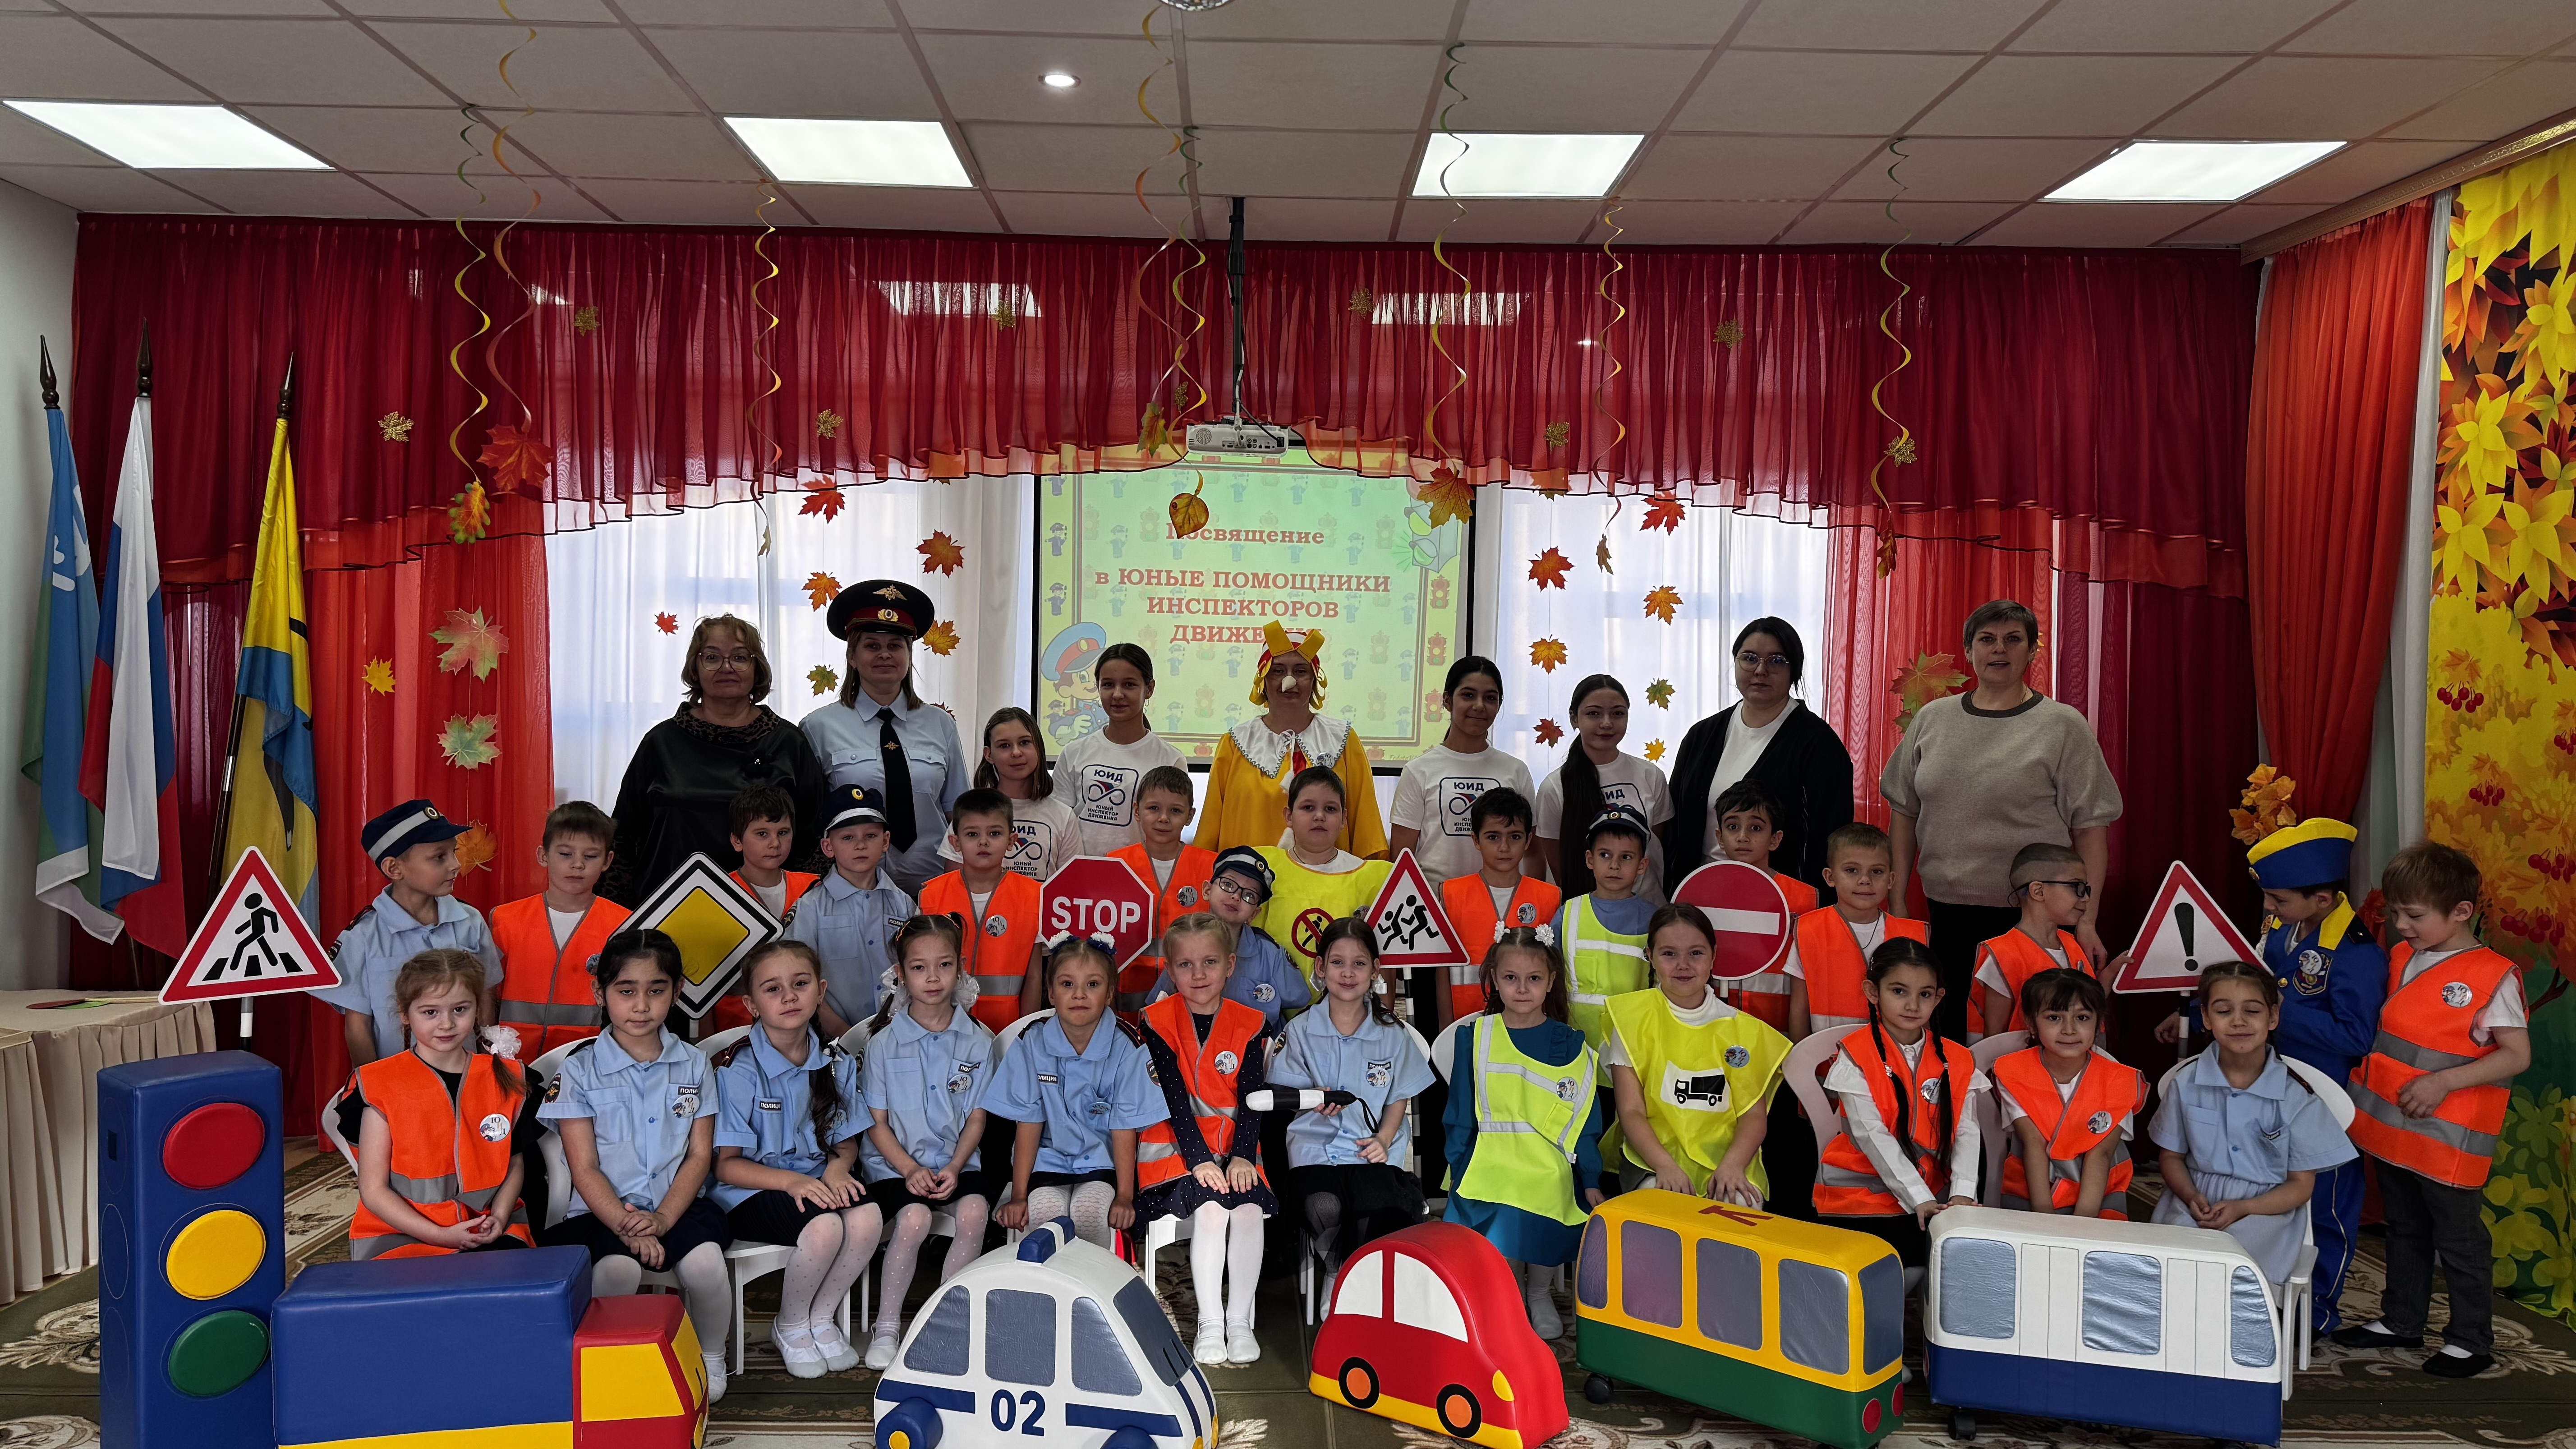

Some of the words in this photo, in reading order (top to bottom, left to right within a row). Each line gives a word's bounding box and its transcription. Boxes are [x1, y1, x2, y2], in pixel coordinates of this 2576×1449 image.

[1095, 572, 1109, 584] в
[1118, 568, 1205, 588] ЮНЫЕ
[1213, 571, 1391, 593] ПОМОЩНИКИ
[1146, 597, 1339, 618] ИНСПЕКТОРОВ
[1169, 625, 1321, 644] ДВИЖЕ
[1094, 769, 1123, 783] ЮИД
[1454, 782, 1484, 792] ЮИД
[1605, 789, 1625, 800] ИД
[1088, 808, 1118, 816] ИНСПЕКТОР
[1051, 896, 1141, 934] STOP
[491, 1117, 506, 1136] ЮИД
[990, 1389, 1046, 1437] 02
